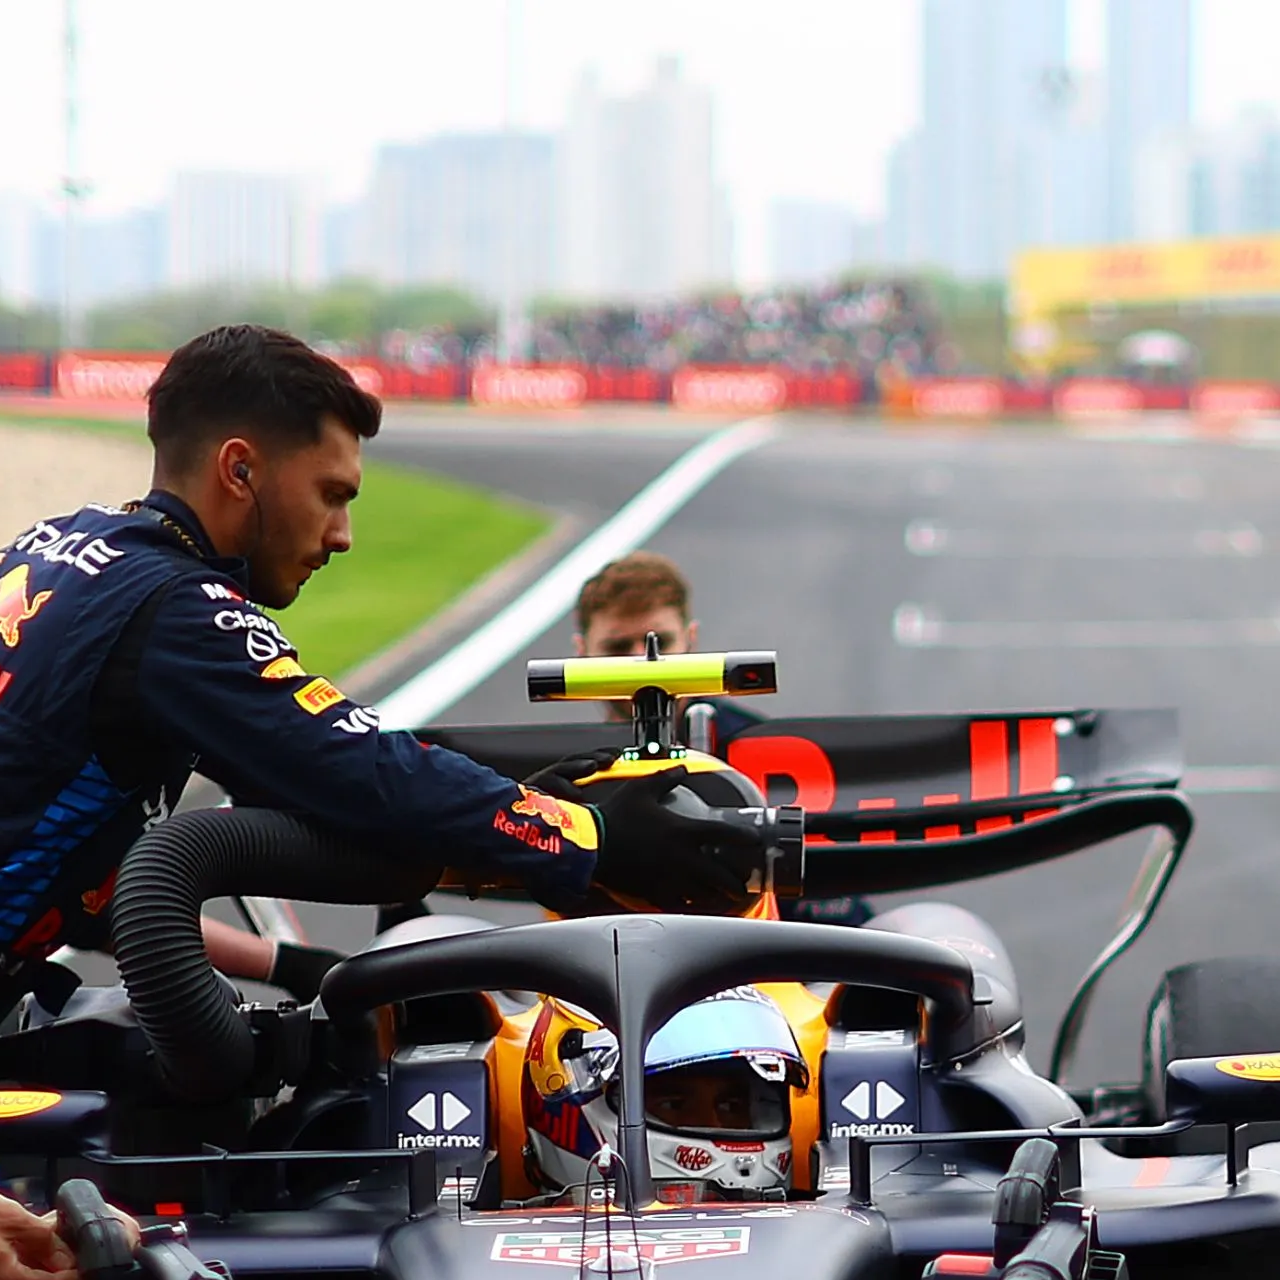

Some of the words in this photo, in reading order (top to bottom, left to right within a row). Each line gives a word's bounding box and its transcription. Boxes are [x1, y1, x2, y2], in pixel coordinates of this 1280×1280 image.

[831, 1122, 915, 1138] inter.mx
[397, 1133, 481, 1149] inter.mx
[517, 1228, 725, 1245] TAG
